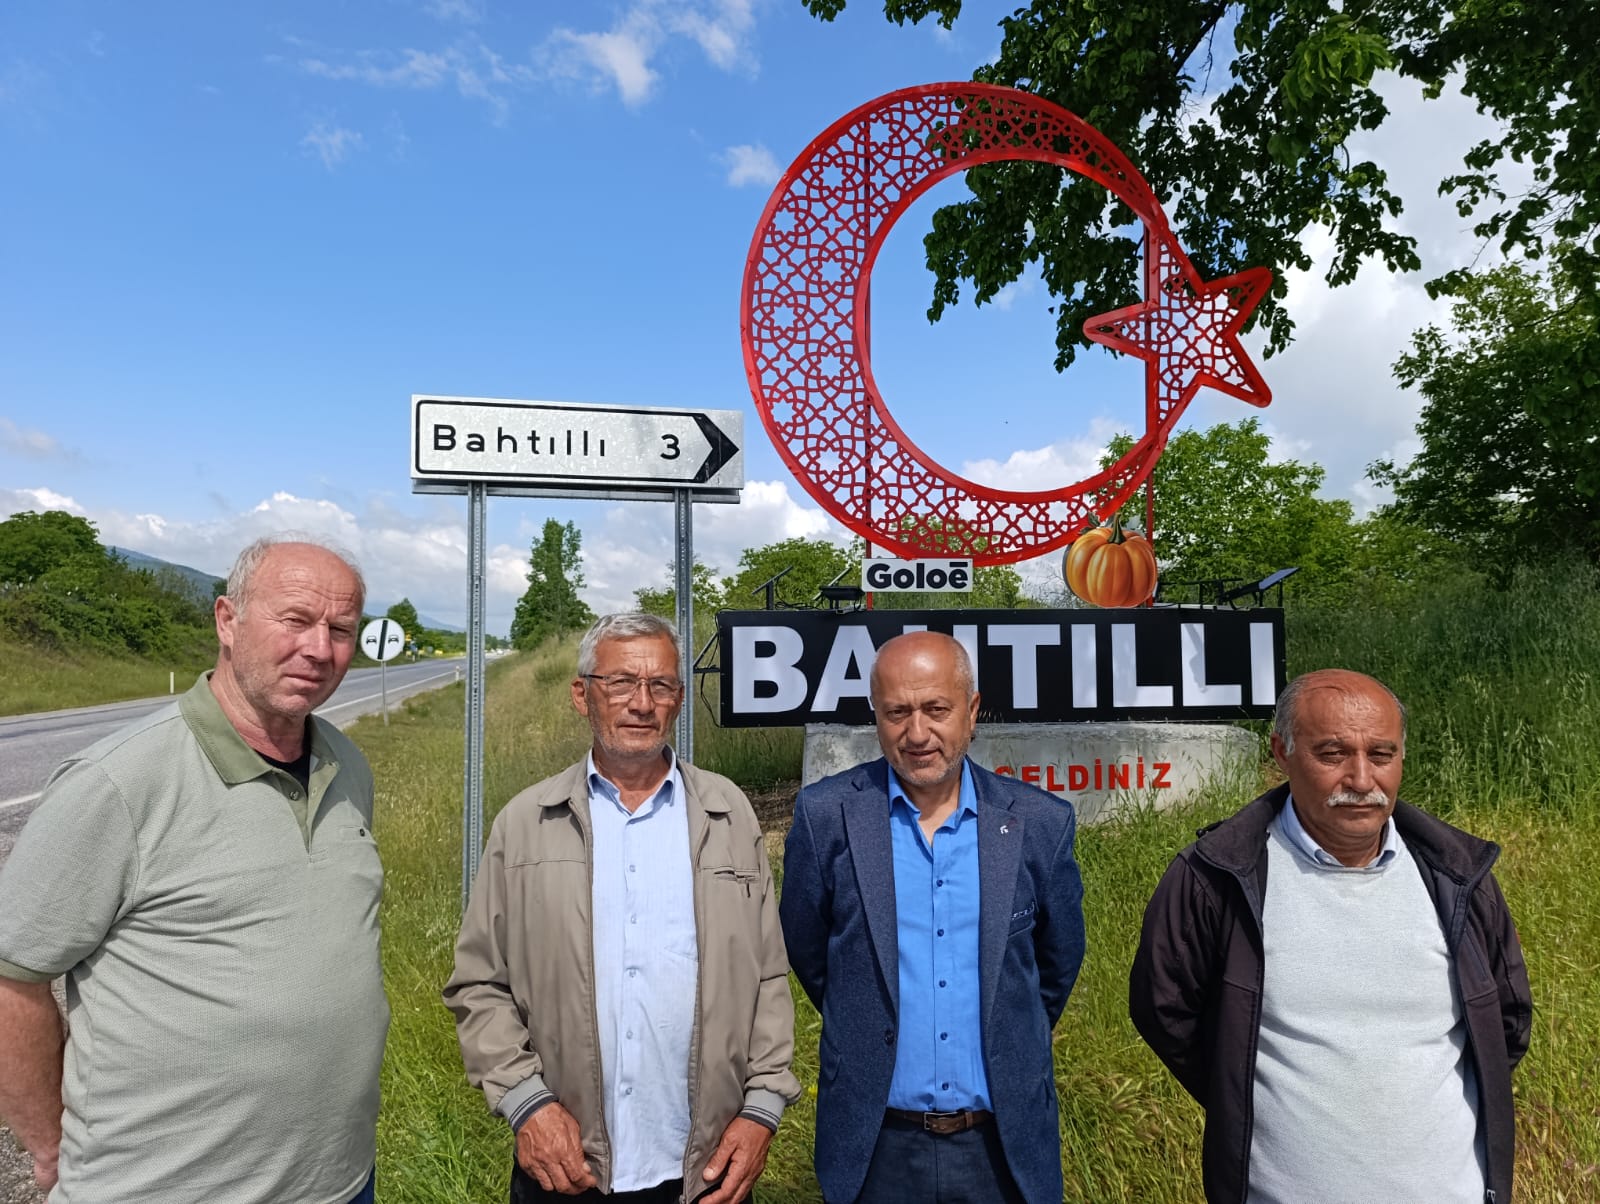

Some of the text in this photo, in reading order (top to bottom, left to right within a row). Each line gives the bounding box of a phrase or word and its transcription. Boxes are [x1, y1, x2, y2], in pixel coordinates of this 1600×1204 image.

[433, 423, 681, 460] Bahtıllı 3
[866, 561, 969, 589] Goloē
